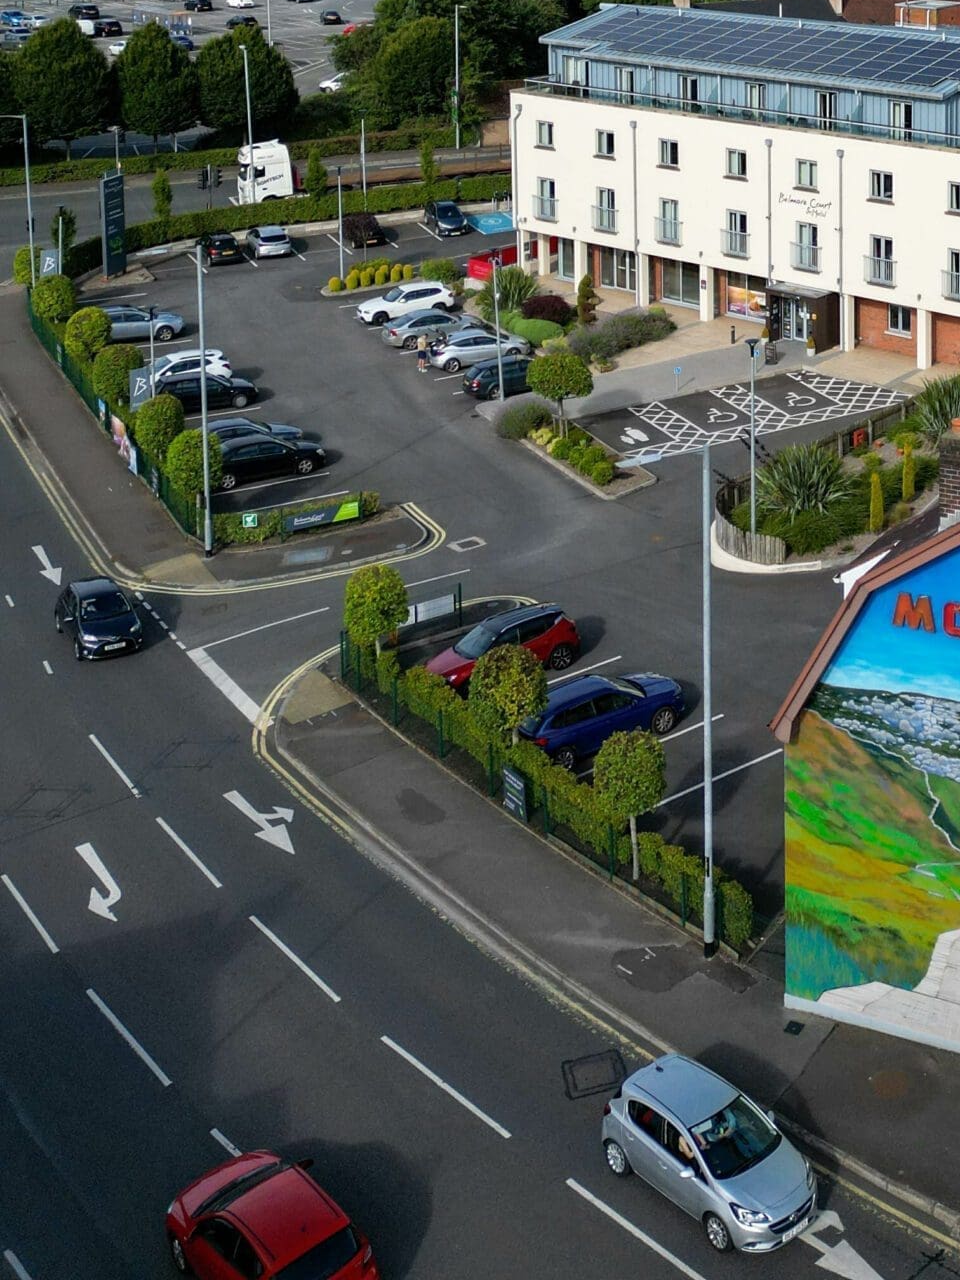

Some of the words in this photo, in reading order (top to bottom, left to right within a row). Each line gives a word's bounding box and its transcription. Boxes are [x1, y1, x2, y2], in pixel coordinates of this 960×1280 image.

[810, 198, 832, 210] Court
[43, 256, 57, 273] B
[133, 376, 148, 397] B
